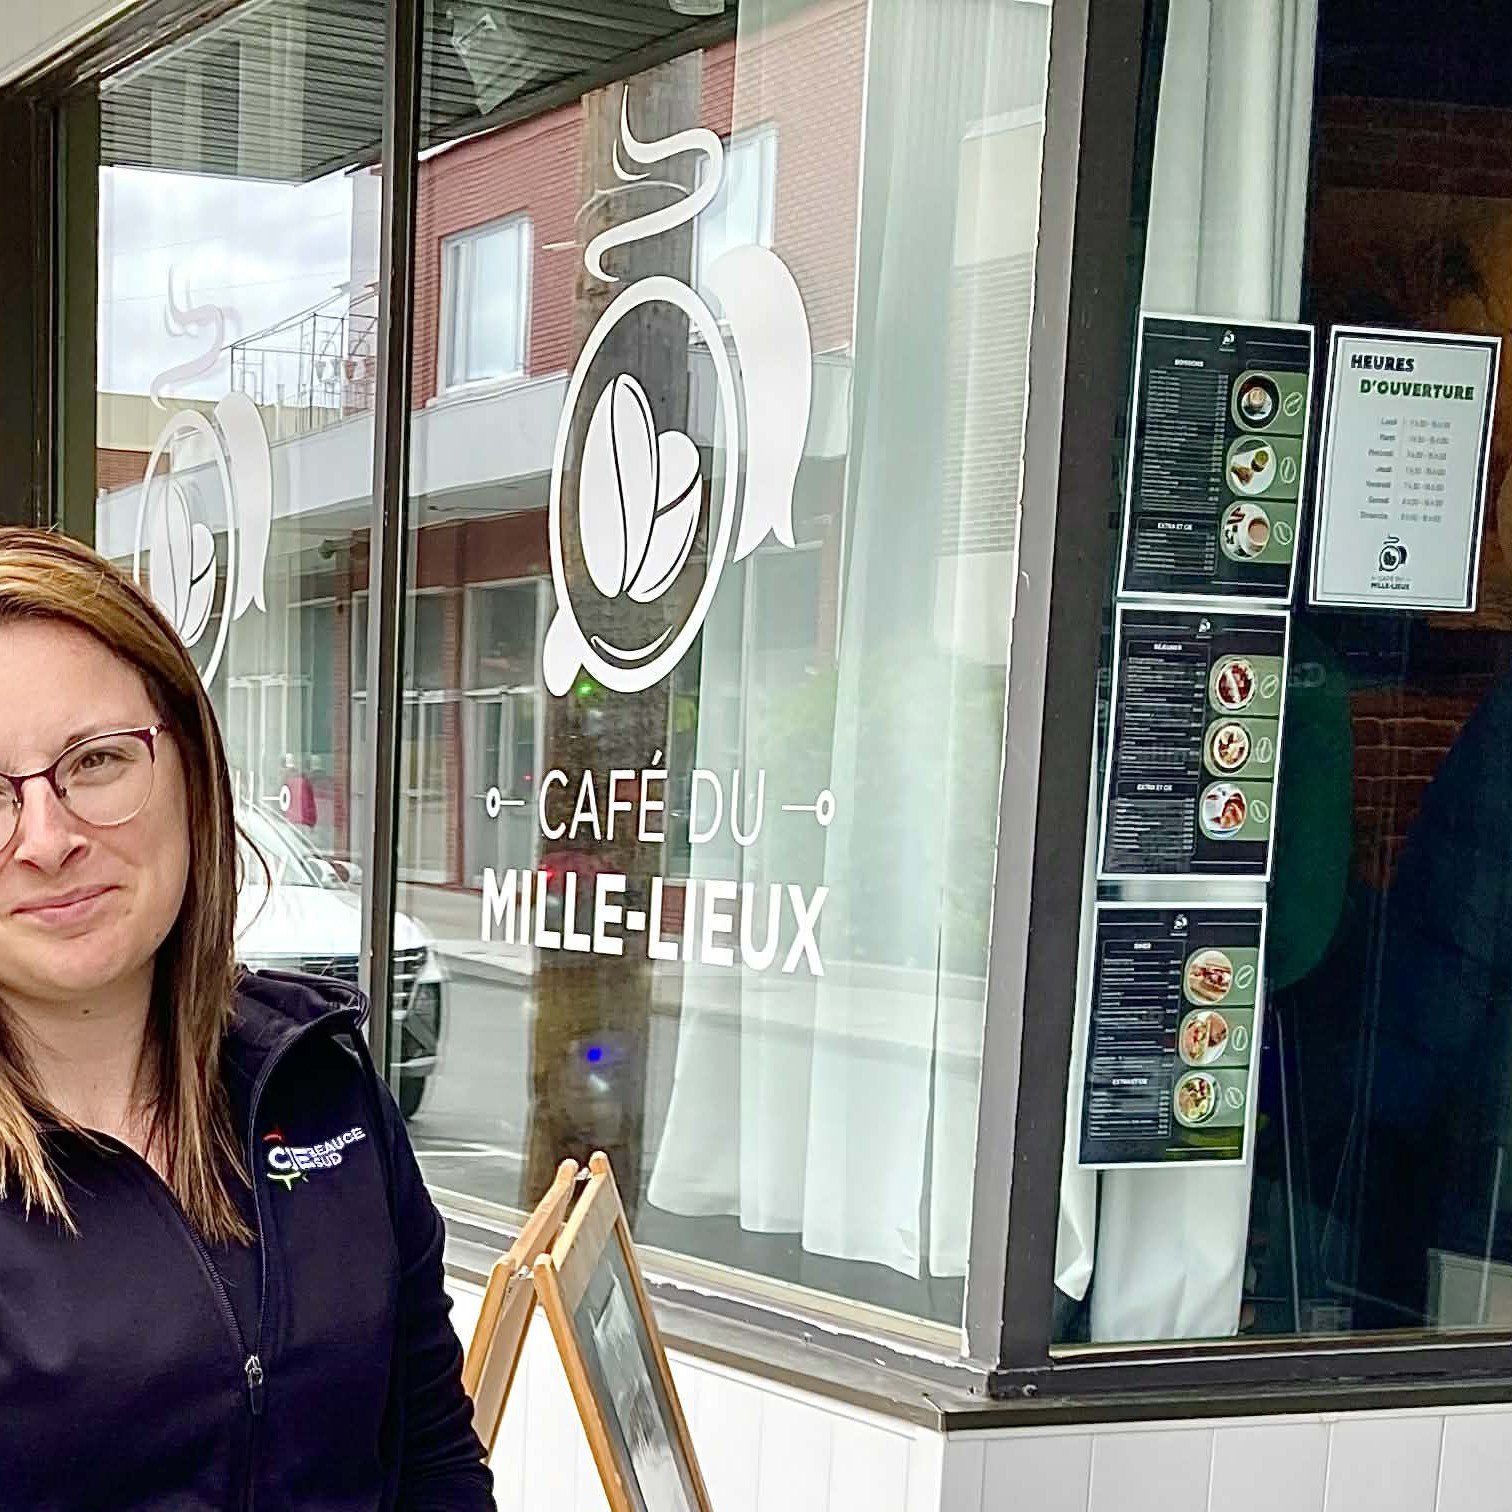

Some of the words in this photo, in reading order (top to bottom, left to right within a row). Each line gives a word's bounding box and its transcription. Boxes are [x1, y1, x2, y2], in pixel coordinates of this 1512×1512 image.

[1350, 354, 1415, 372] HEURES
[1360, 378, 1475, 401] D'OUVERTURE
[538, 749, 669, 844] CAFÉ
[688, 767, 766, 847] DU
[481, 866, 830, 977] MILLE-LIEUX
[313, 1152, 343, 1169] SUD
